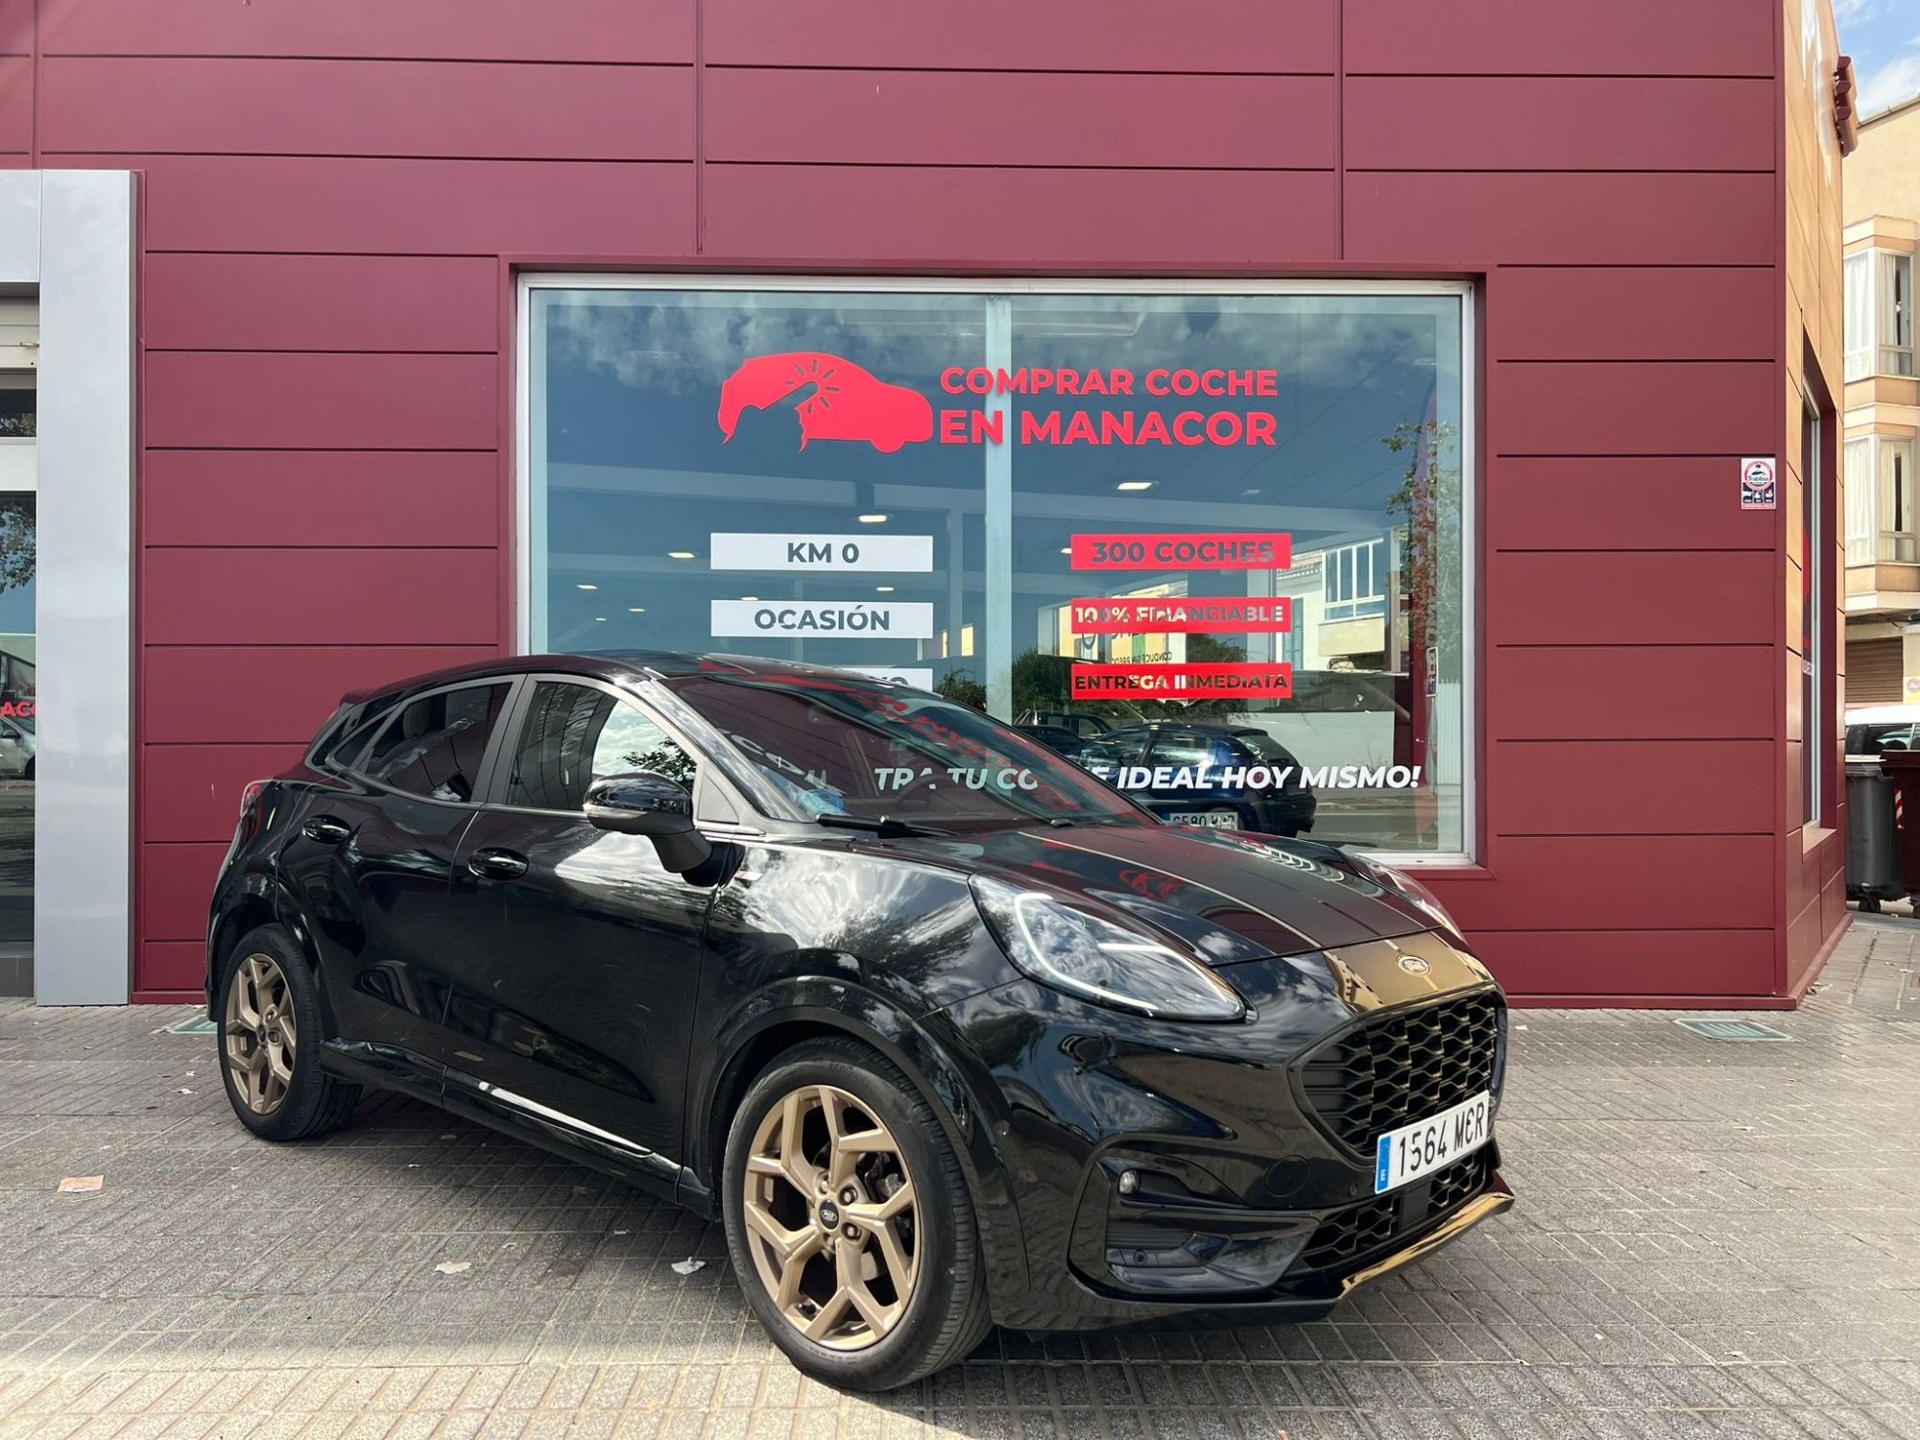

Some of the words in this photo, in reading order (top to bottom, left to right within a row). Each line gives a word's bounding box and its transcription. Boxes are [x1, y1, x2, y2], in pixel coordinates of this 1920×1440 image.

[940, 367, 1134, 396] COMPRAR
[1145, 369, 1278, 396] COCHE
[940, 409, 1004, 445] EN
[1021, 410, 1277, 446] MANACOR
[787, 542, 832, 563] KM
[842, 543, 860, 564] 0
[1091, 542, 1146, 563] 300
[1154, 541, 1275, 563] COCHES
[754, 605, 890, 631] OCASIÓN
[1075, 606, 1130, 623] 100%
[1136, 605, 1284, 623] FINANCIABLE
[1075, 674, 1169, 690] ENTREGA
[1174, 674, 1288, 690] INMEDIATA
[947, 767, 988, 790] TU
[1117, 766, 1213, 789] IDEAL
[1221, 766, 1294, 789] HOY
[1299, 765, 1422, 789] MISMO!
[1399, 1119, 1447, 1177] 1564
[1454, 1101, 1485, 1152] MCR
